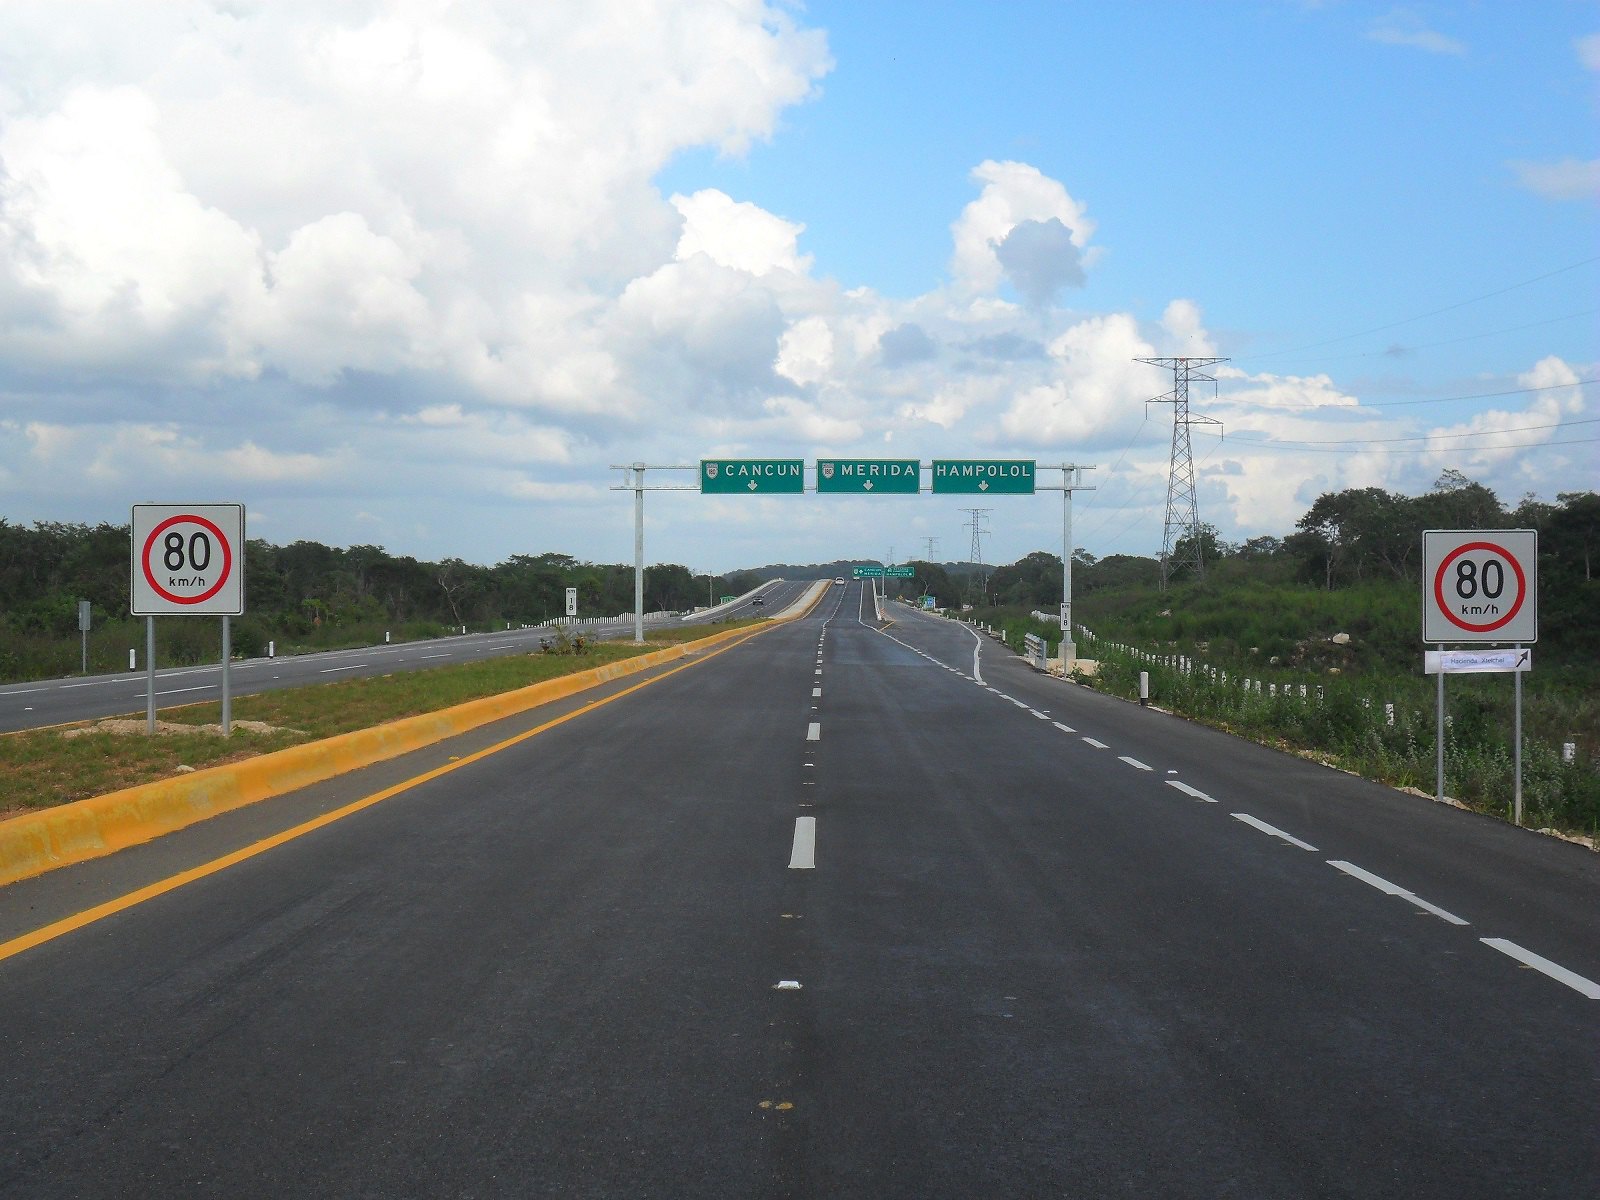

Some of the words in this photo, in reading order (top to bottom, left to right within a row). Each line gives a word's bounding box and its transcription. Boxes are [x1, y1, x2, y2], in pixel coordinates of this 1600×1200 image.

[725, 464, 801, 477] CANCUN
[841, 464, 915, 477] MERIDA
[936, 464, 1031, 477] HAMPOLOL
[164, 532, 210, 571] 80
[169, 576, 205, 587] km/h
[1456, 559, 1504, 599] 80
[1461, 604, 1499, 615] km/h
